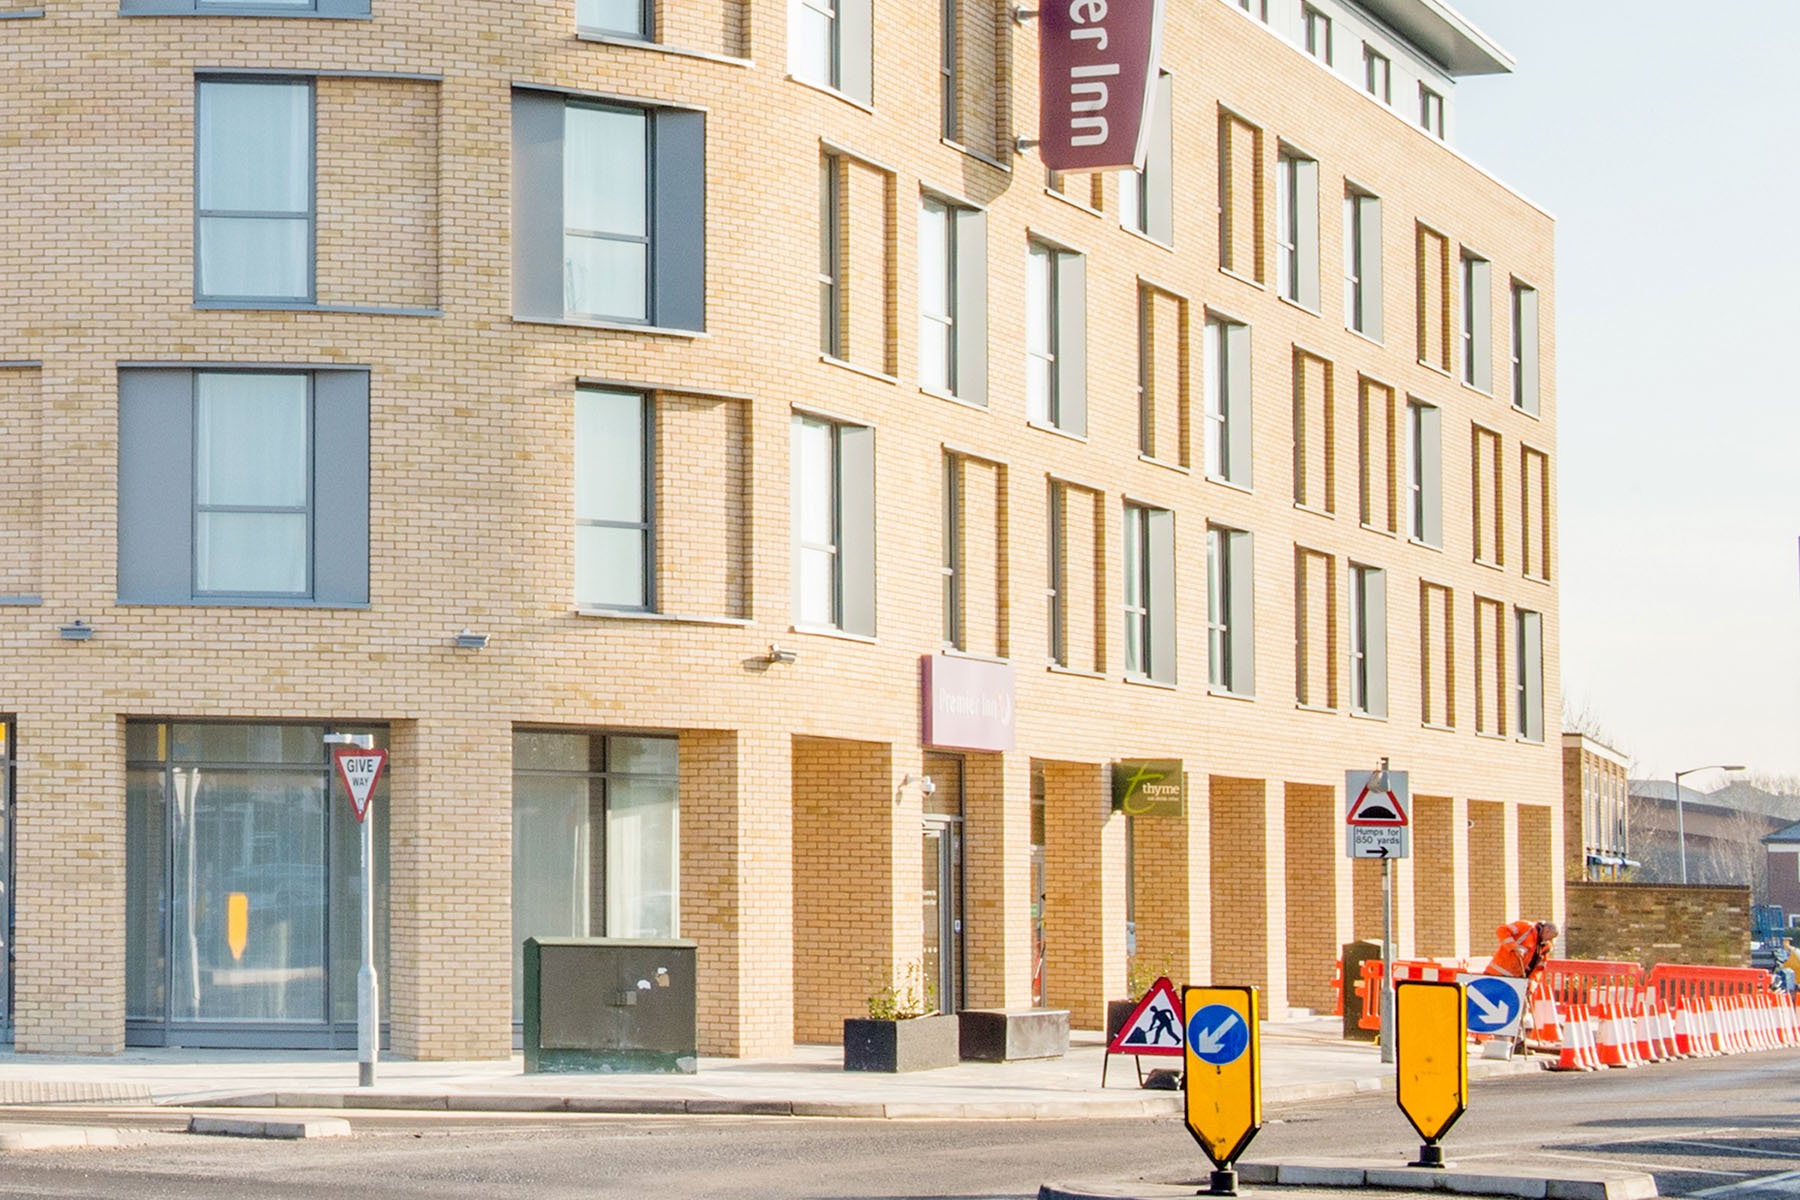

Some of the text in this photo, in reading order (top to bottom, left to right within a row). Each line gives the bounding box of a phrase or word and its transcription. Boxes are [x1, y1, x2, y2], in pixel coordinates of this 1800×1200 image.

[1069, 62, 1121, 147] Inn
[346, 759, 374, 773] GIVE
[352, 777, 369, 786] WAY
[1142, 782, 1180, 797] thyme
[1356, 828, 1399, 836] Humps for
[1356, 836, 1400, 845] 850 yards
